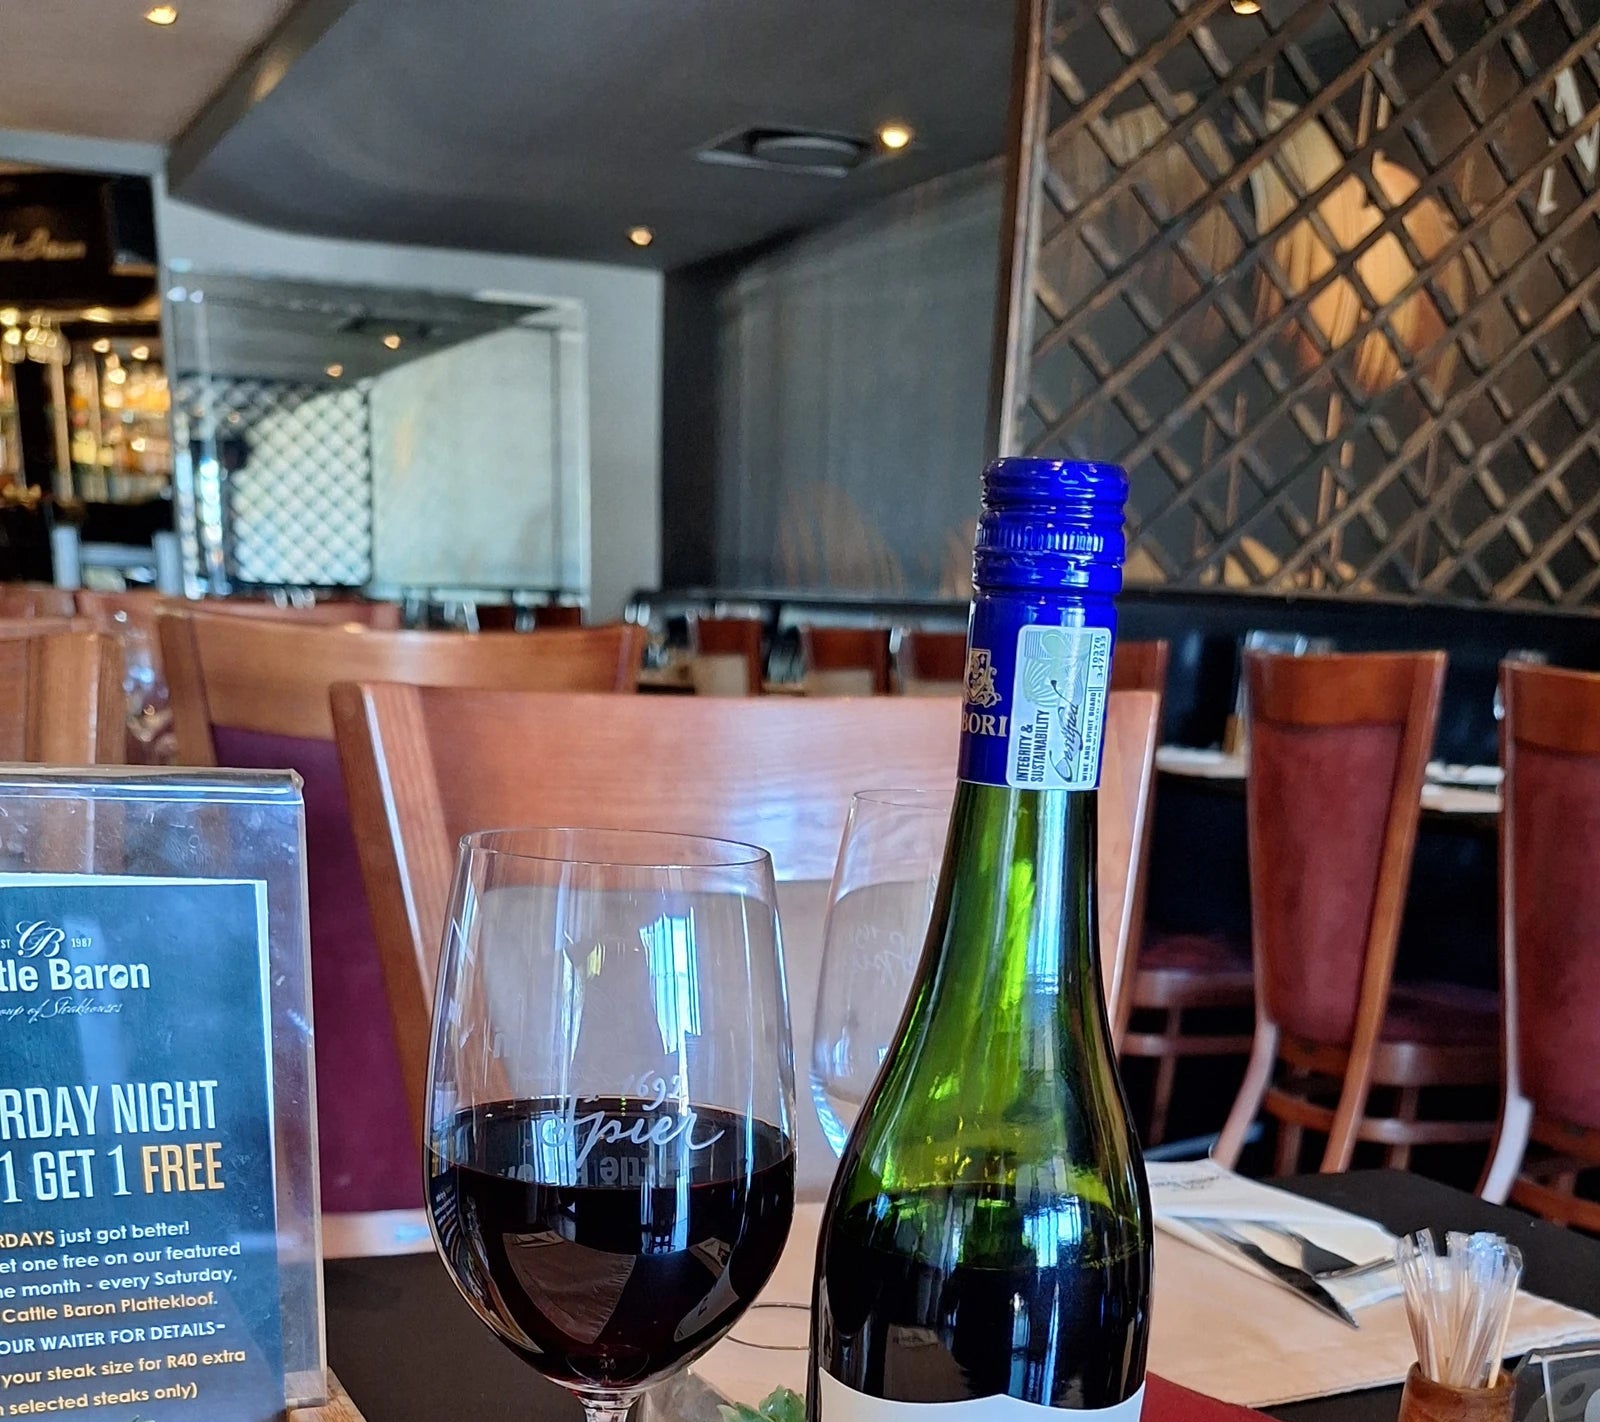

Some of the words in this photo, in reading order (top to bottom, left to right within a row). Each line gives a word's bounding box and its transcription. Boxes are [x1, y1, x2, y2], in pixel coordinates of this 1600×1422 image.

[1088, 692, 1096, 717] BOARD
[1020, 724, 1033, 734] &
[1049, 680, 1084, 783] Certified
[1085, 720, 1093, 743] SPIRIT
[1016, 735, 1033, 782] INTEGRITY
[1030, 709, 1050, 783] SUSTAINABILITY
[71, 937, 93, 949] 1987
[49, 958, 151, 991] Baron
[41, 996, 123, 1018] Steakhouses
[0, 1085, 99, 1140] RDAY
[111, 1079, 218, 1134] NIGHT
[0, 1150, 23, 1204] 1
[33, 1149, 96, 1201] GET
[108, 1144, 132, 1196] 1
[142, 1142, 225, 1194] FREE
[59, 1228, 92, 1247] just
[96, 1225, 127, 1244] got
[132, 1220, 190, 1238] better!
[22, 1258, 58, 1272] one
[63, 1254, 99, 1269] free
[104, 1253, 128, 1265] on
[133, 1250, 162, 1263] our
[166, 1242, 241, 1260] featured
[22, 1279, 81, 1297] month
[99, 1275, 150, 1290] every
[154, 1268, 238, 1286] Saturday,
[2, 1306, 58, 1323] Cattle
[63, 1303, 116, 1318] Baron
[121, 1291, 218, 1313] Plattekloof.
[40, 1331, 105, 1351] WAITER
[110, 1328, 145, 1344] FOR
[150, 1321, 226, 1340] DETAILS-
[1, 1371, 42, 1388] your
[47, 1363, 97, 1381] steak
[101, 1360, 134, 1375] size
[139, 1357, 162, 1371] for
[167, 1352, 197, 1368] R40
[202, 1349, 246, 1365] extra
[9, 1393, 89, 1415] selected
[93, 1388, 149, 1406] steaks
[154, 1382, 198, 1399] only)
